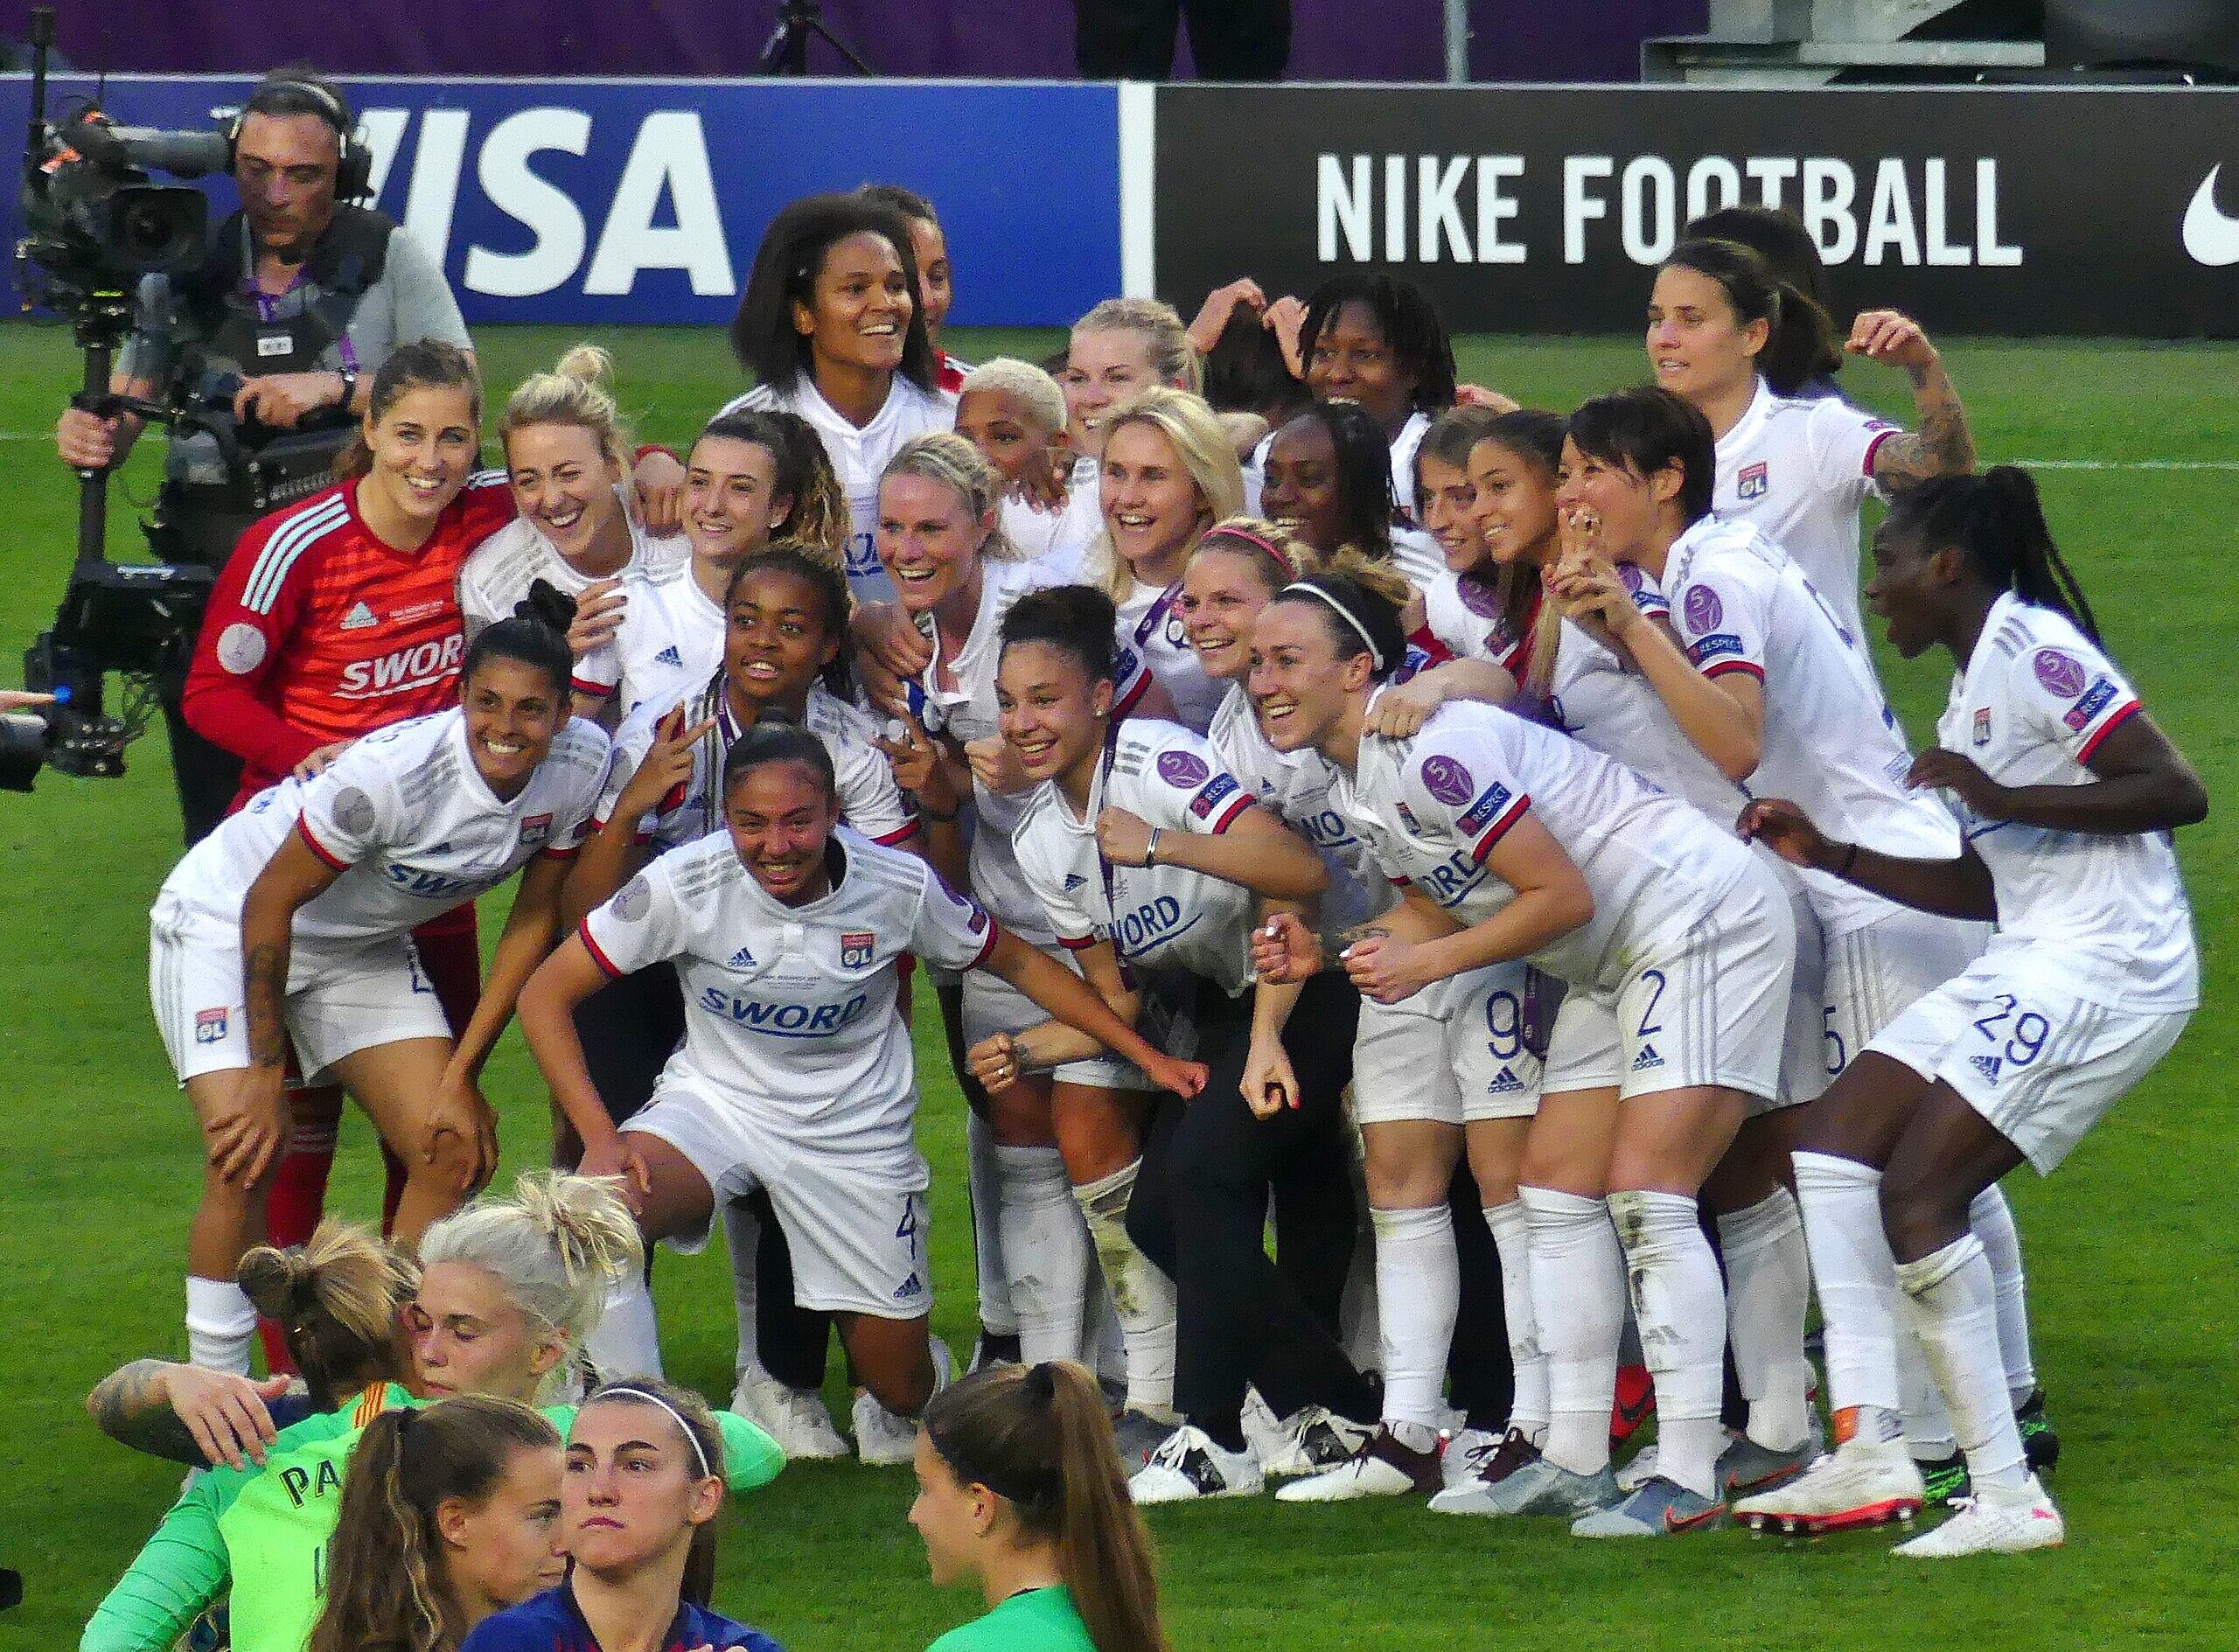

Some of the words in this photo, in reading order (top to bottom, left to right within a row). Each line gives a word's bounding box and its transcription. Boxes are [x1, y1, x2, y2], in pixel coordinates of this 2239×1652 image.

[1317, 153, 1527, 263] NIKE
[338, 633, 464, 691] SWOR
[700, 986, 868, 1031] SWORD
[1486, 989, 1522, 1060] 9
[1638, 969, 1666, 1037] 2
[1973, 993, 2050, 1067] 29
[895, 1195, 916, 1260] 4
[279, 1460, 341, 1509] PA
